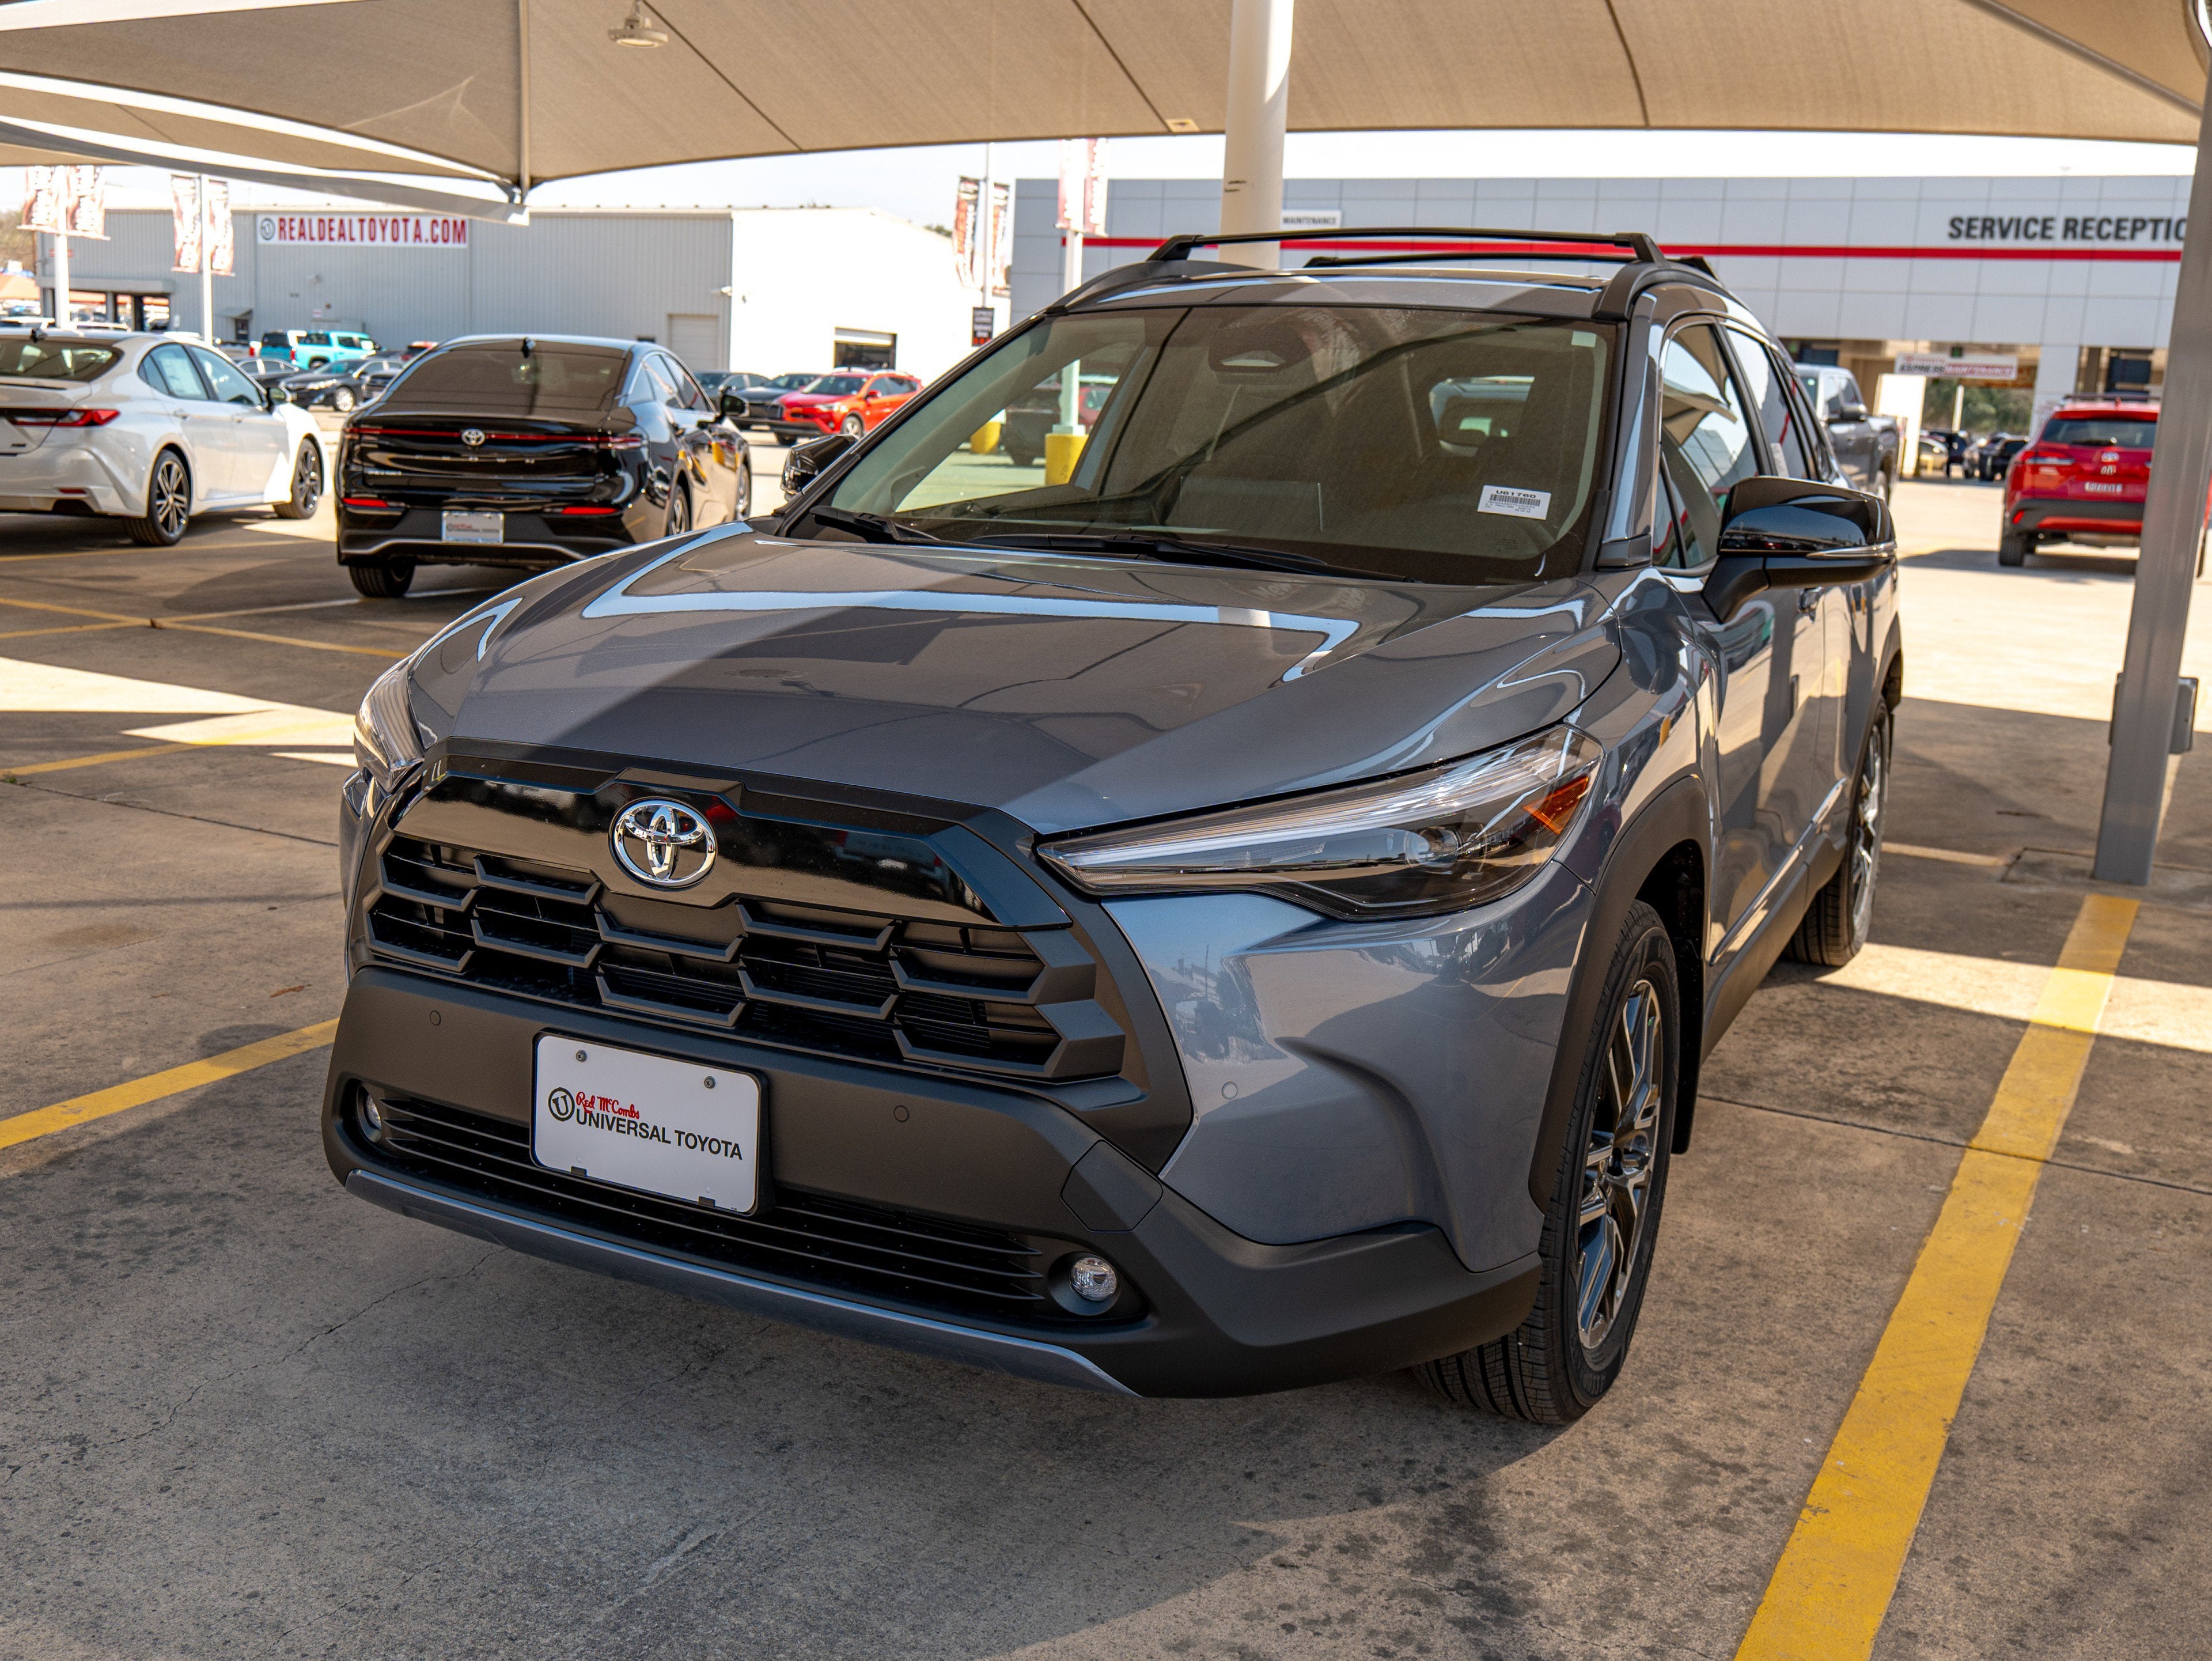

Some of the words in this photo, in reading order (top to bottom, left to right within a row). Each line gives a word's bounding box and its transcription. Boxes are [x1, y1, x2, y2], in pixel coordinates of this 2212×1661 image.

[278, 217, 467, 244] REALDEALTOYOTA.COM
[1949, 217, 2054, 240] SERVICE
[576, 1091, 596, 1114] Red
[596, 1095, 640, 1119] McCombs
[576, 1108, 671, 1145] UNIVERSAL
[674, 1129, 743, 1161] TOYOTA
